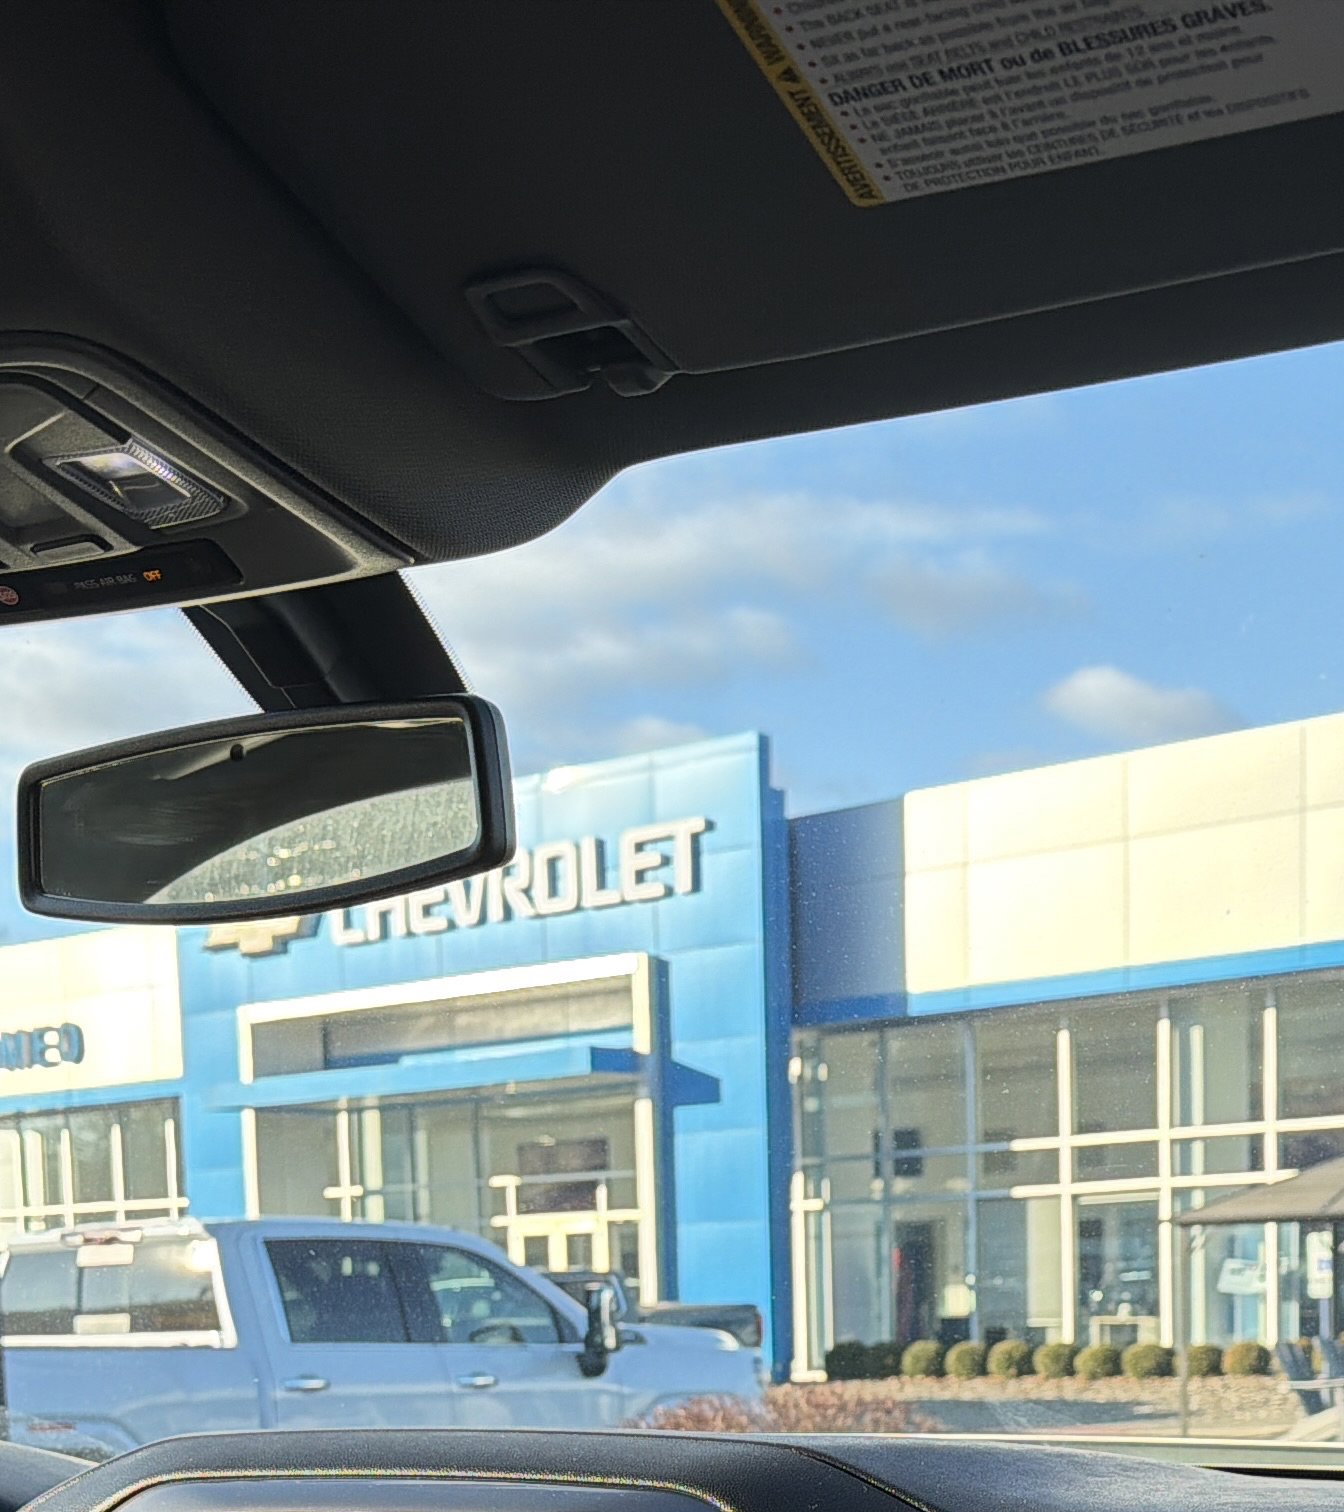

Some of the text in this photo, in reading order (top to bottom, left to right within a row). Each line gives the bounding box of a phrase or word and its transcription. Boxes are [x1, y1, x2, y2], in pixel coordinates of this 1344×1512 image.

[827, 0, 1273, 107] DANGER DE MORT ou de BLESSURES GRAVES.
[330, 817, 709, 945] CHEVROLET
